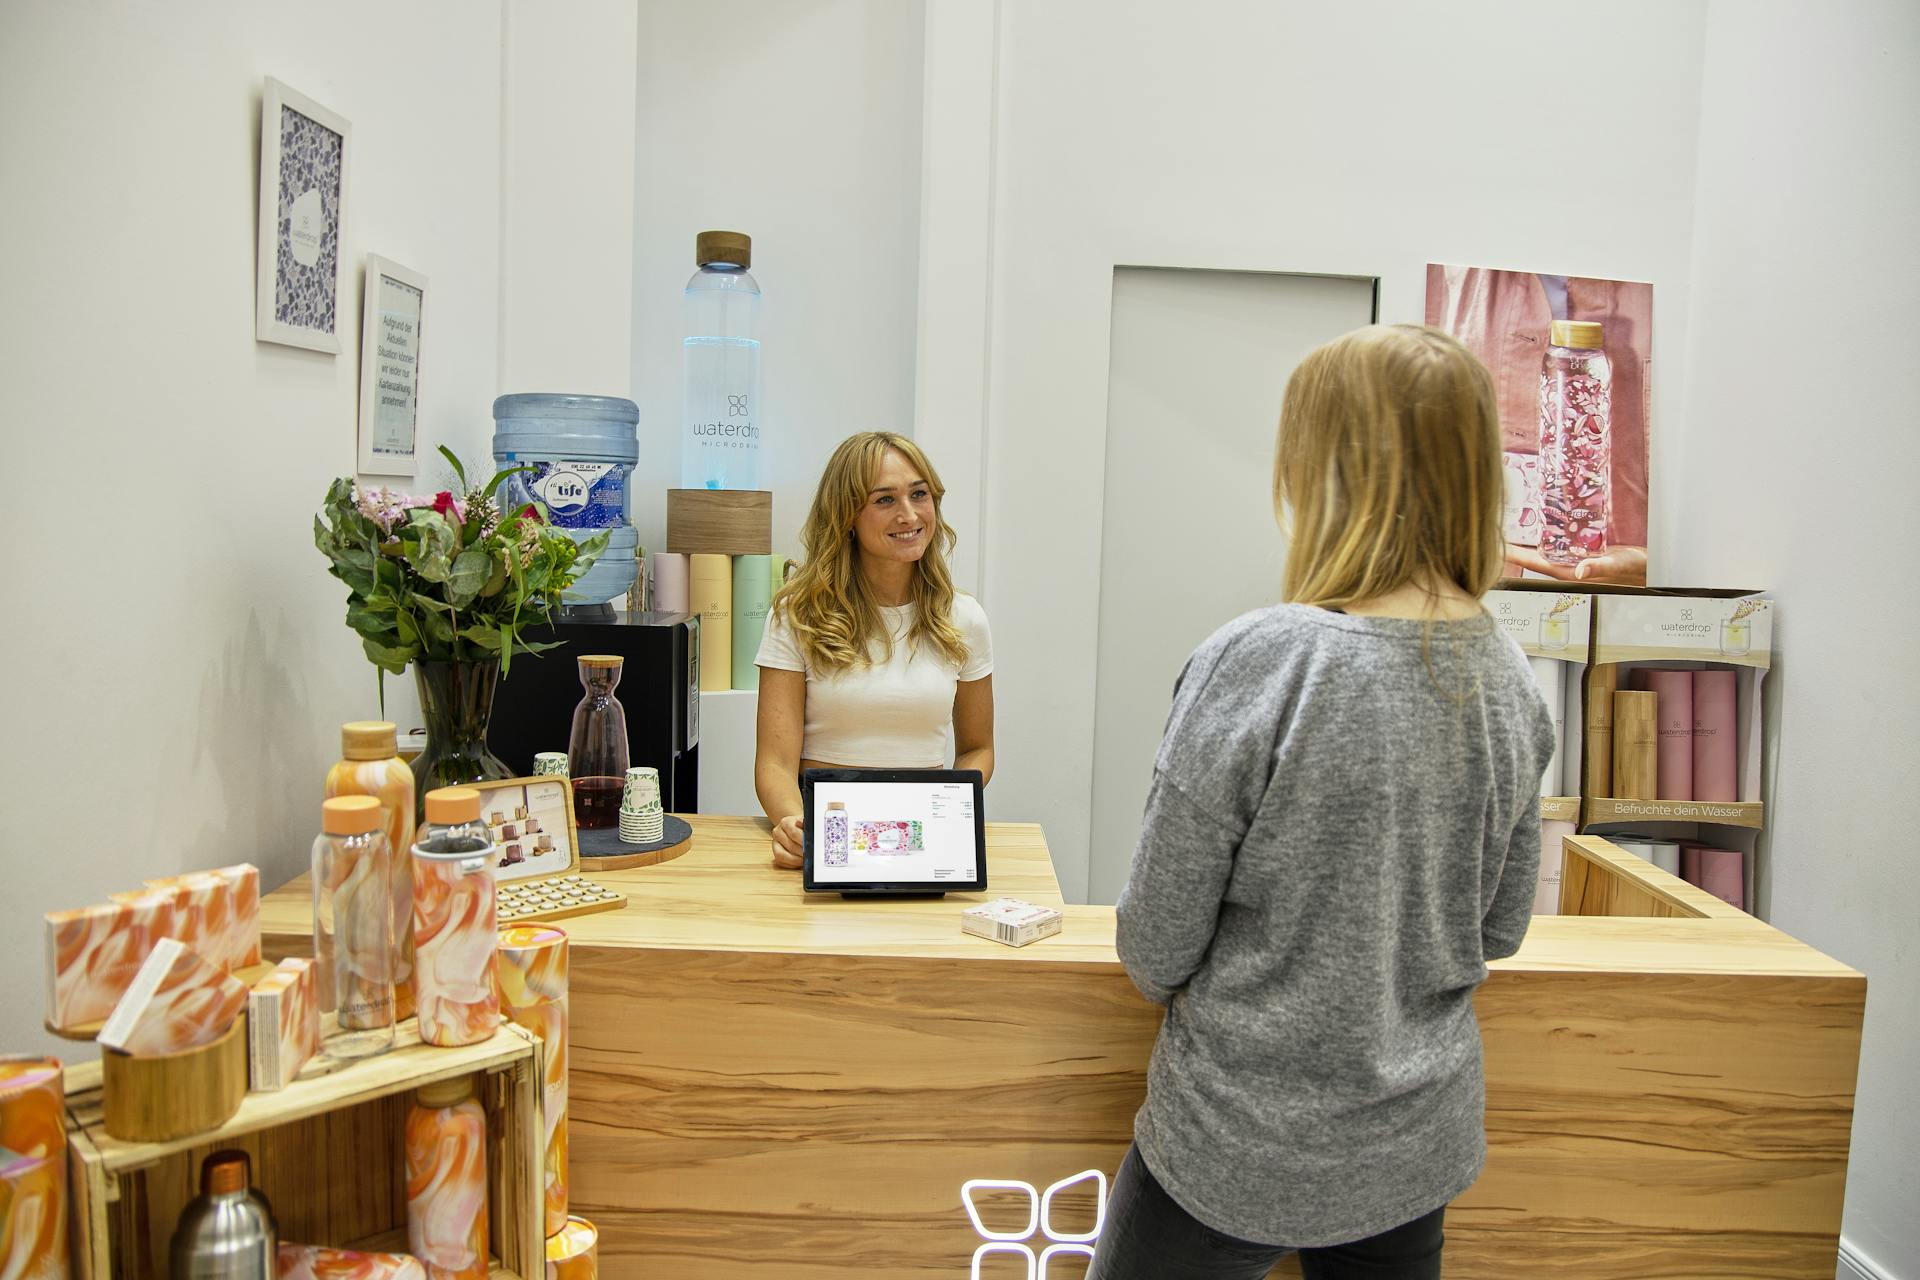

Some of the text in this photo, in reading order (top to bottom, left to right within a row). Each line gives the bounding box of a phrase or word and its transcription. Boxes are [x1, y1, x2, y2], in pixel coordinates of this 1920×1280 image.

[383, 316, 413, 334] Aufgrund der
[378, 345, 398, 360] Situation
[381, 362, 389, 373] wir
[402, 369, 410, 378] nur
[693, 421, 760, 439] waterdro
[1497, 616, 1531, 627] erdrop
[1540, 802, 1561, 812] sser
[1614, 802, 1745, 818] Befruchte dein Wasser
